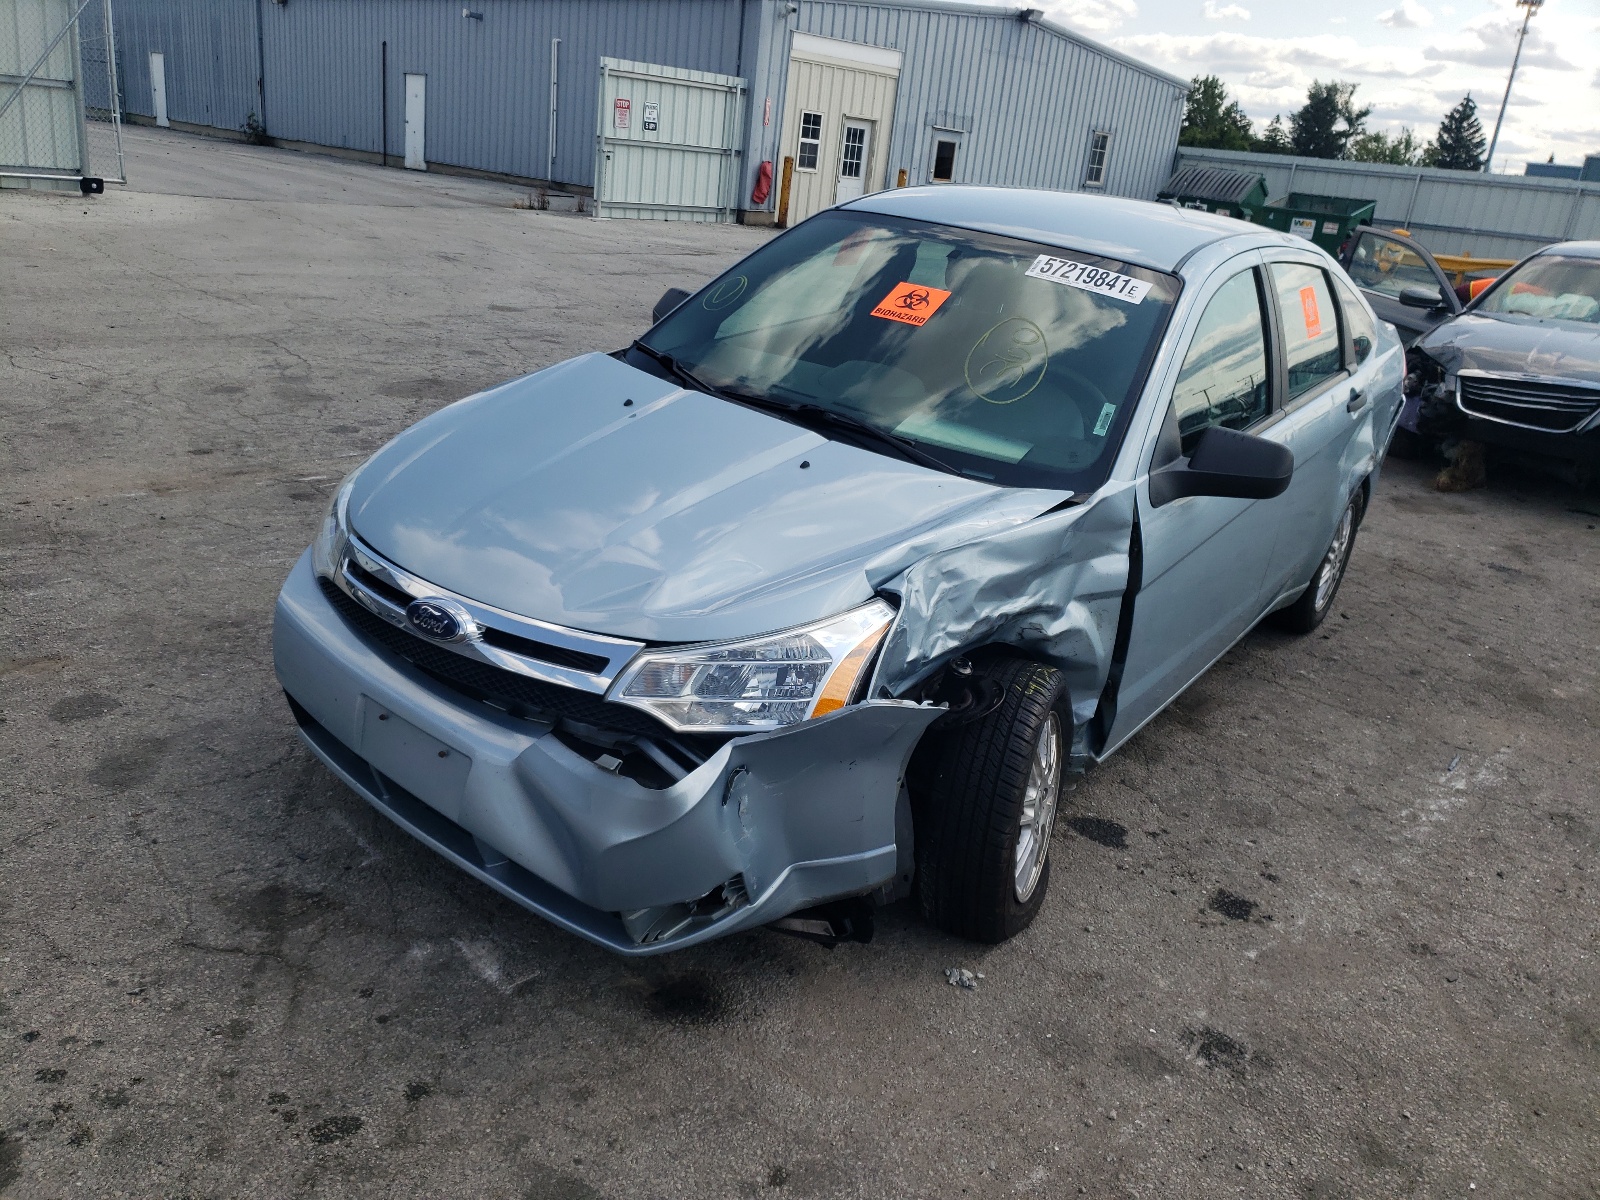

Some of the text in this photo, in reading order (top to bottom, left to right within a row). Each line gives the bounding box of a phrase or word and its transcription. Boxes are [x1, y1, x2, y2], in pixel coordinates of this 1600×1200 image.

[616, 101, 630, 109] STOP
[1040, 257, 1132, 294] 57219841
[1128, 285, 1139, 295] E
[874, 307, 926, 324] BIOHAZARD
[413, 605, 449, 634] Ford
